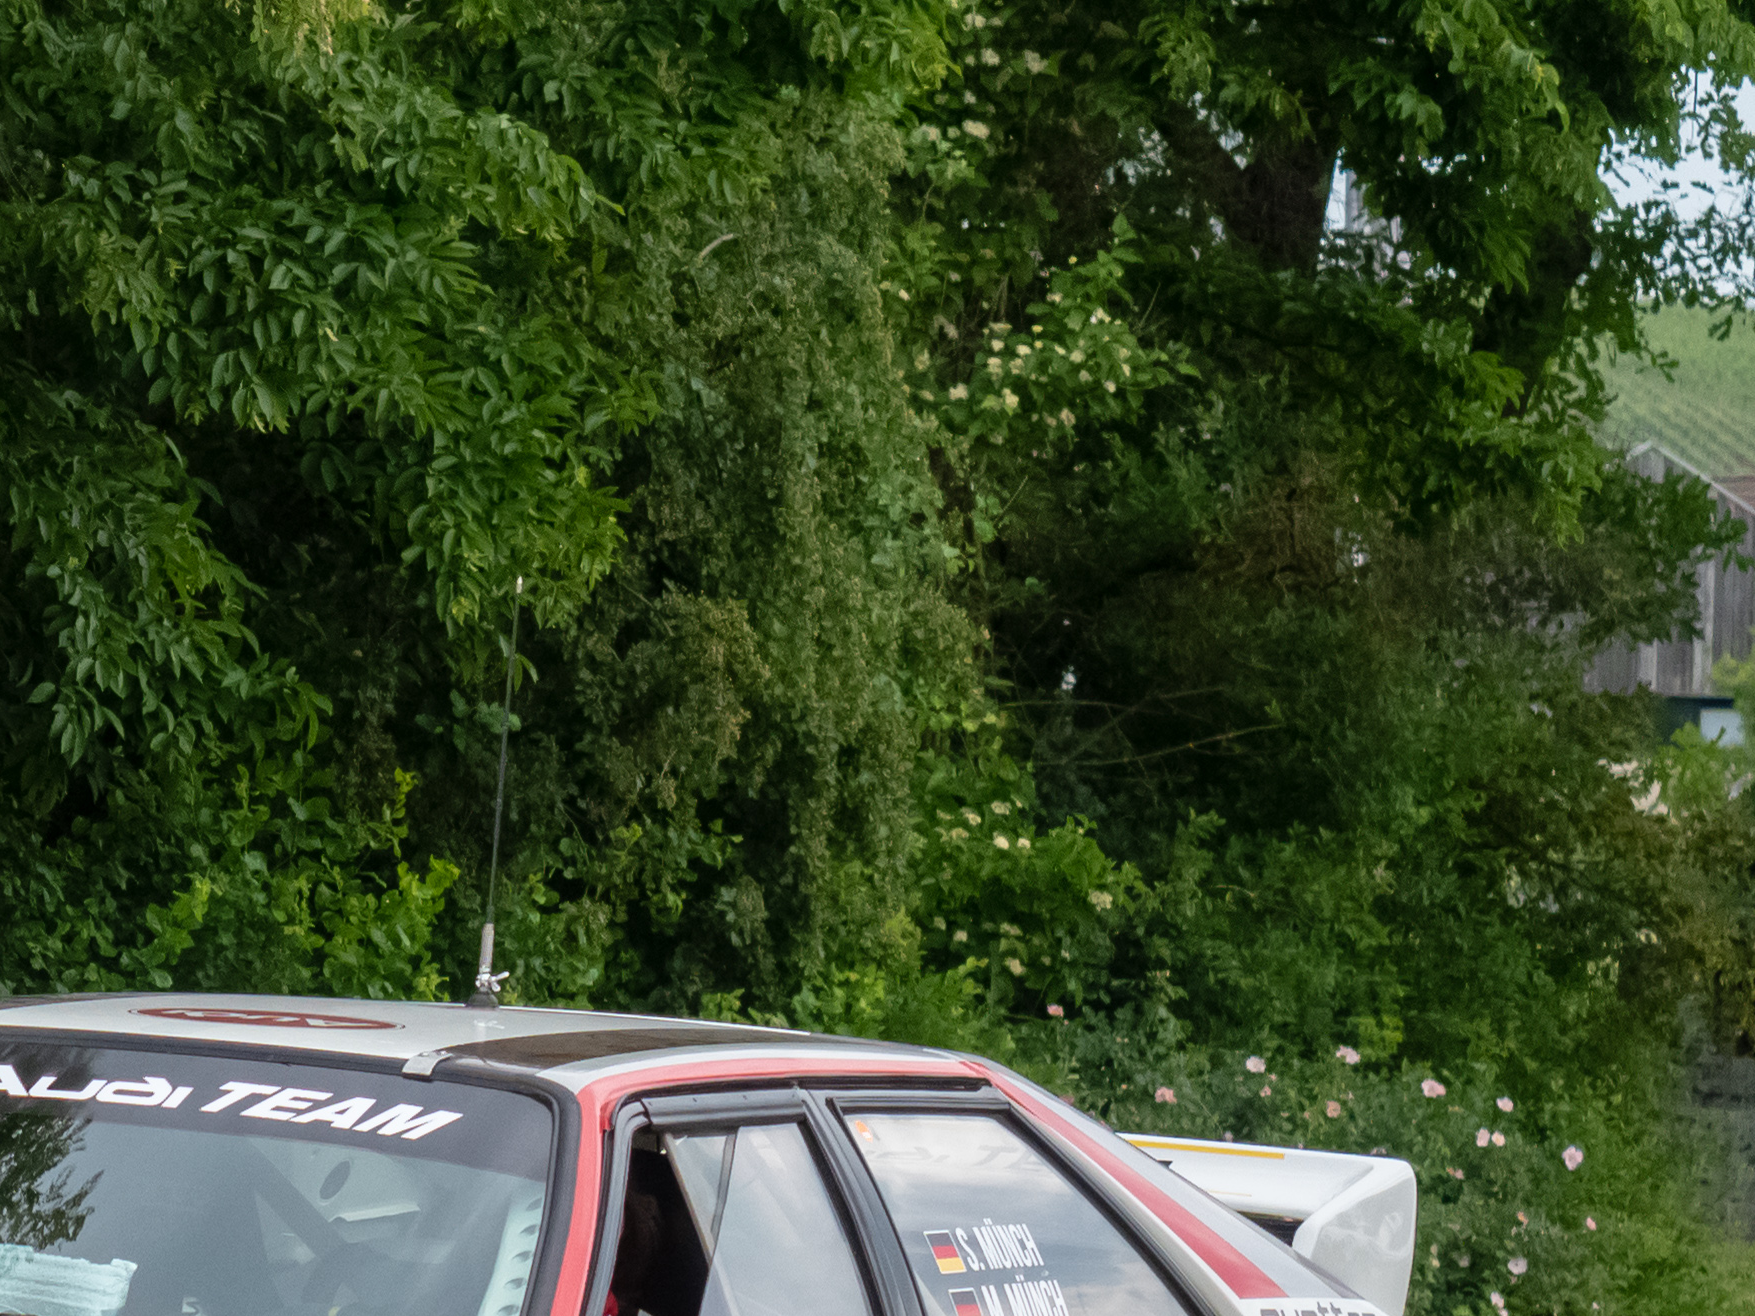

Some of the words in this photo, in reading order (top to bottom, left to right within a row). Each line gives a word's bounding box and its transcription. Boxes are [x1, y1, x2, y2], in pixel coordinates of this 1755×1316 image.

[200, 1080, 464, 1140] TEAM
[955, 1227, 986, 1271] S.
[972, 1217, 1045, 1270] MÜNCH
